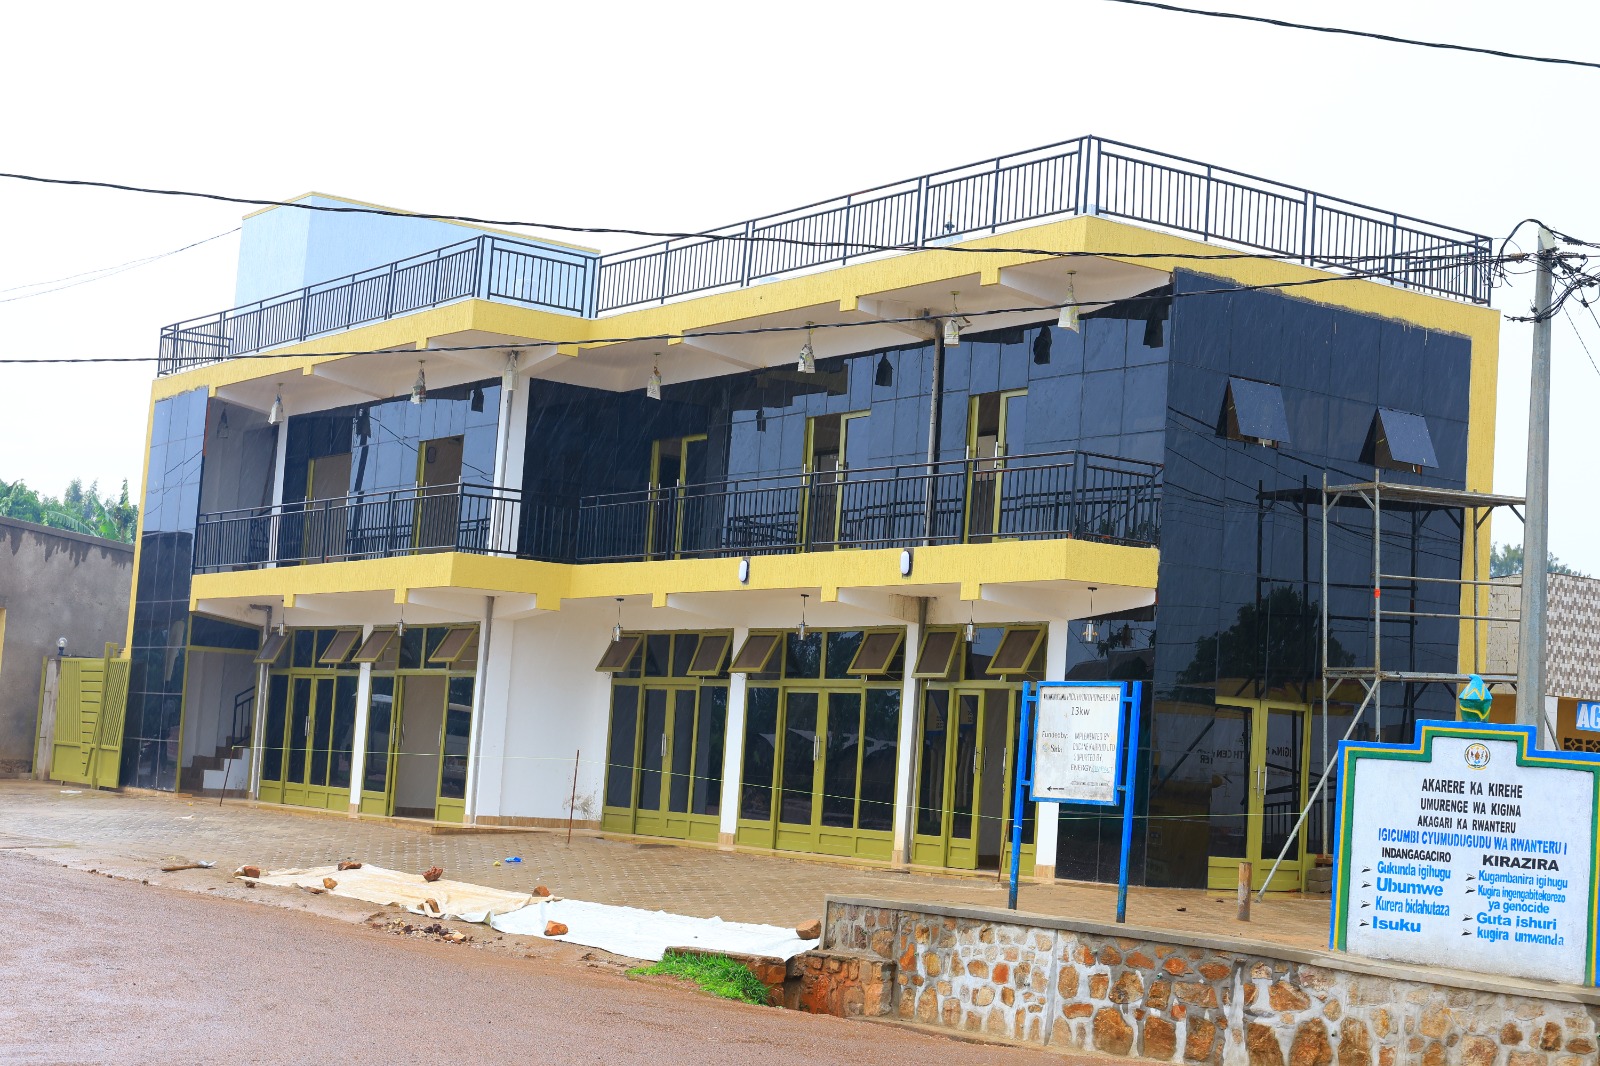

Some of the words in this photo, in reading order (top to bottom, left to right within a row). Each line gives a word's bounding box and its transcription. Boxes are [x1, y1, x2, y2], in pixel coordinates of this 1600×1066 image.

[1422, 778, 1465, 794] AKARERE
[1470, 781, 1483, 796] KA
[1488, 782, 1523, 798] KIREHE
[1420, 798, 1468, 814] UMURENGE
[1473, 801, 1486, 815] WA
[1491, 803, 1522, 817] KIGINA
[1417, 815, 1452, 828] AKAGARI
[1457, 818, 1468, 830] KA
[1472, 819, 1516, 834] RWANTERU
[1378, 828, 1419, 844] IGICUMBI
[1422, 831, 1491, 849] CYUMUDUGUDU
[1494, 837, 1508, 850] WA
[1510, 838, 1562, 854] RWANTERU
[1382, 847, 1452, 863] INDANGAGACIRO
[1482, 854, 1559, 871] KIRAZIRA
[1378, 861, 1416, 876] Gukunda
[1419, 864, 1451, 882] igihugu
[1478, 870, 1534, 885] Kugambanira
[1376, 876, 1444, 896] Ubumwe
[1478, 885, 1500, 899] Kugira
[1376, 896, 1403, 912] Kurera
[1405, 898, 1450, 916] bidahutaza
[1488, 900, 1500, 912] ya
[1503, 902, 1549, 914] genocide
[1372, 916, 1421, 932] Isuku
[1477, 912, 1511, 926] Guta
[1516, 916, 1557, 930] ishuri
[1477, 926, 1509, 942] kugira
[1515, 932, 1564, 946] umwanda
